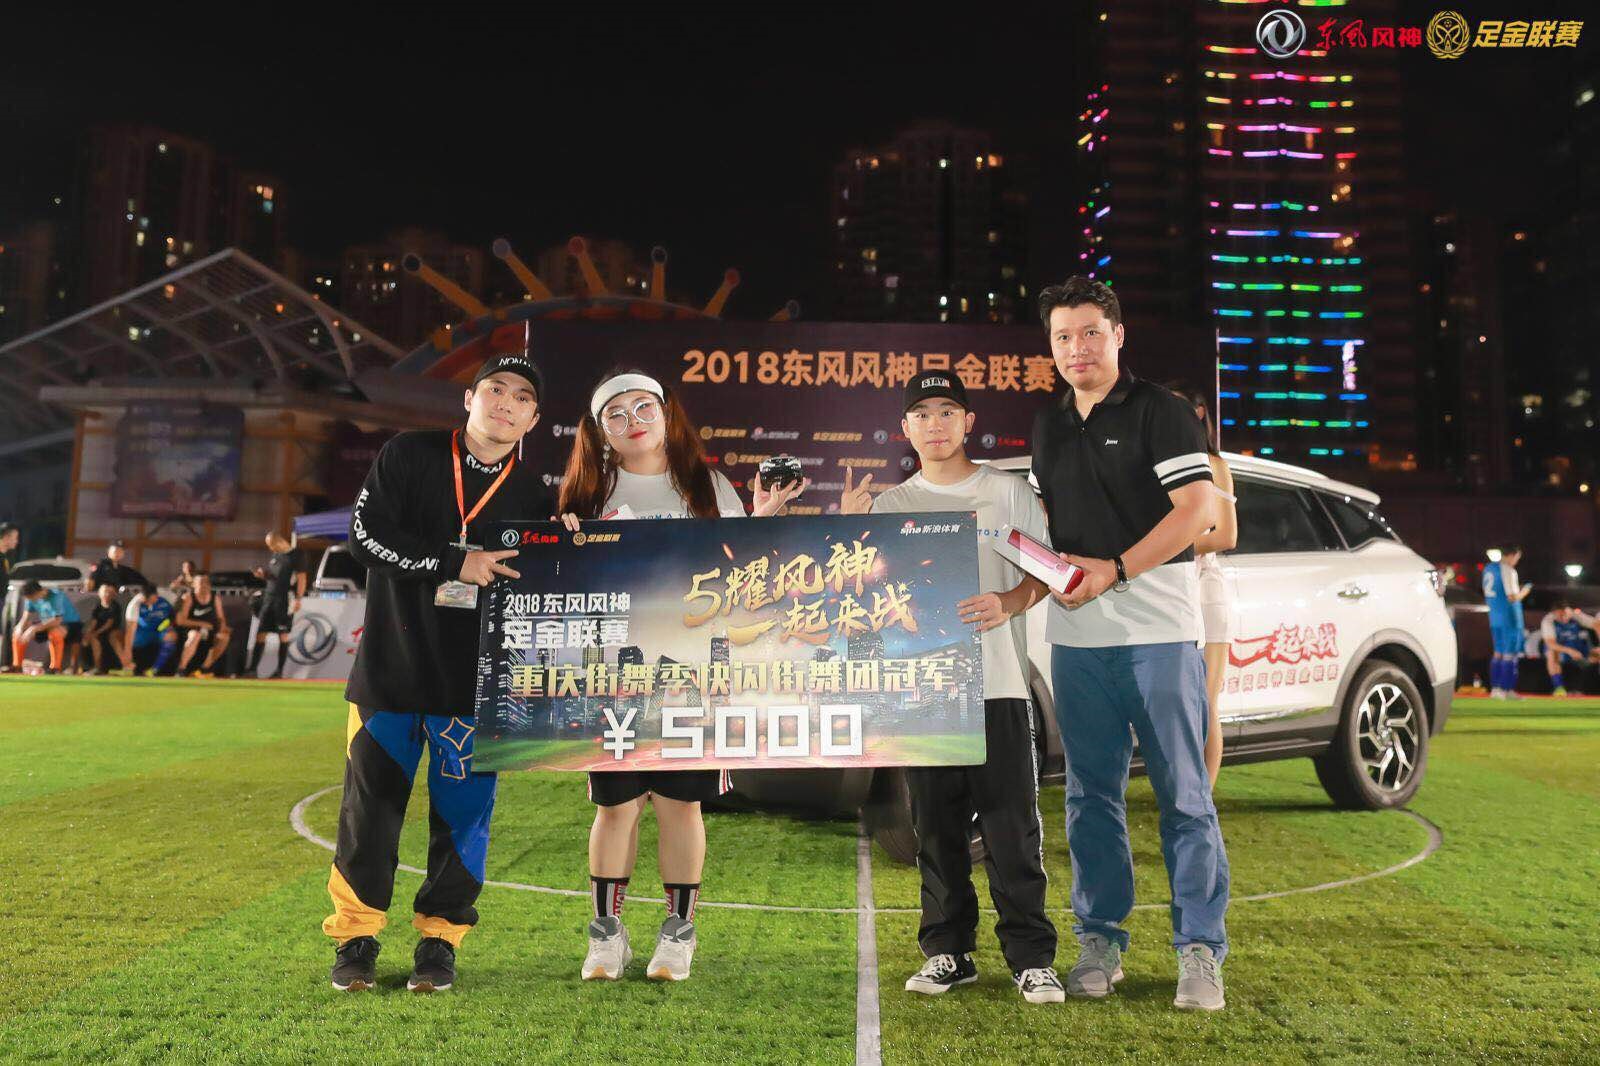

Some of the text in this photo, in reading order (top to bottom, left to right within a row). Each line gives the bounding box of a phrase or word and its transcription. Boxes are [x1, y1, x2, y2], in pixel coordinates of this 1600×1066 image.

[361, 537, 400, 563] NEED
[683, 540, 878, 628] 5耀风神
[501, 618, 630, 649] 足金联赛
[727, 583, 918, 646] 一起来战
[510, 657, 956, 698] 重庆街舞季快闪街舞团冠军
